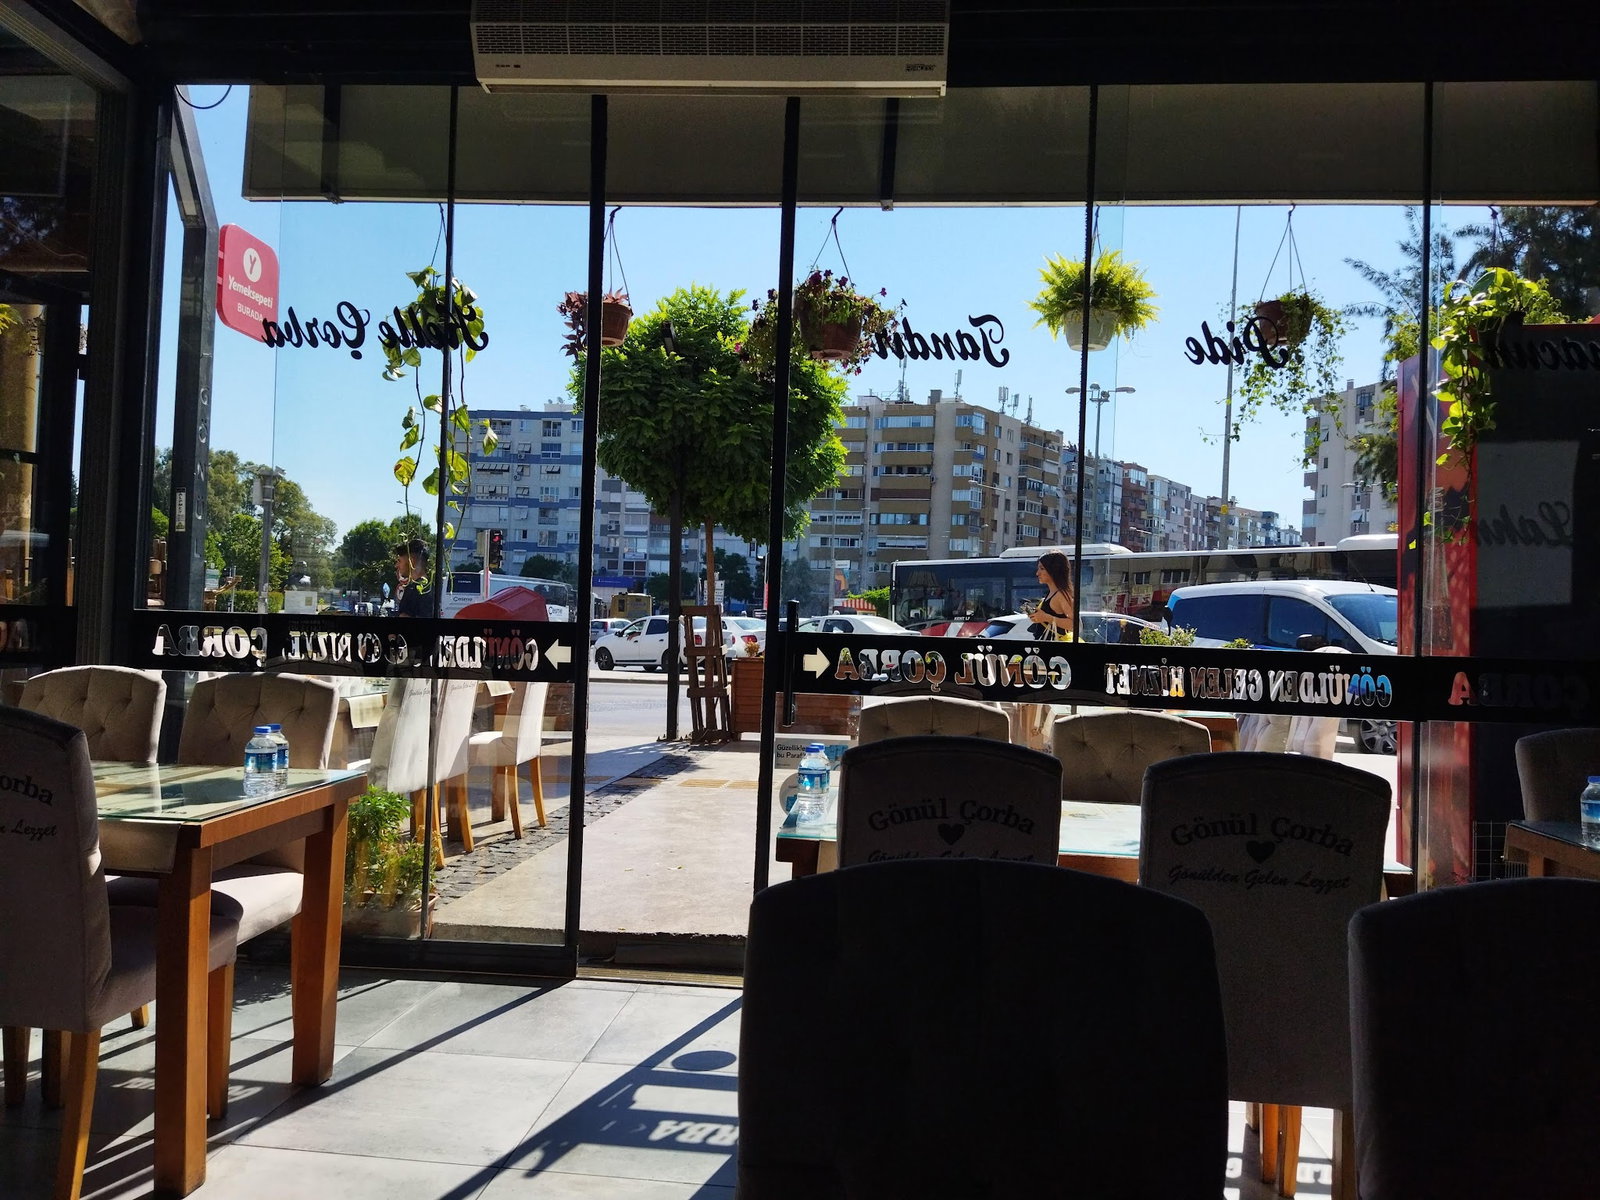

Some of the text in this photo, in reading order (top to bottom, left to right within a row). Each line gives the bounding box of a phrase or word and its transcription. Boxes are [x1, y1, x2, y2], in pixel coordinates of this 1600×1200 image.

[228, 275, 273, 309] Yemeksepeti
[237, 302, 264, 321] BURADA
[776, 751, 785, 759] bu
[868, 798, 1035, 835] Gönül Çorba
[1170, 812, 1354, 857] Gönül Çorba
[1168, 864, 1351, 895] Gönülden Gelen Lezzet
